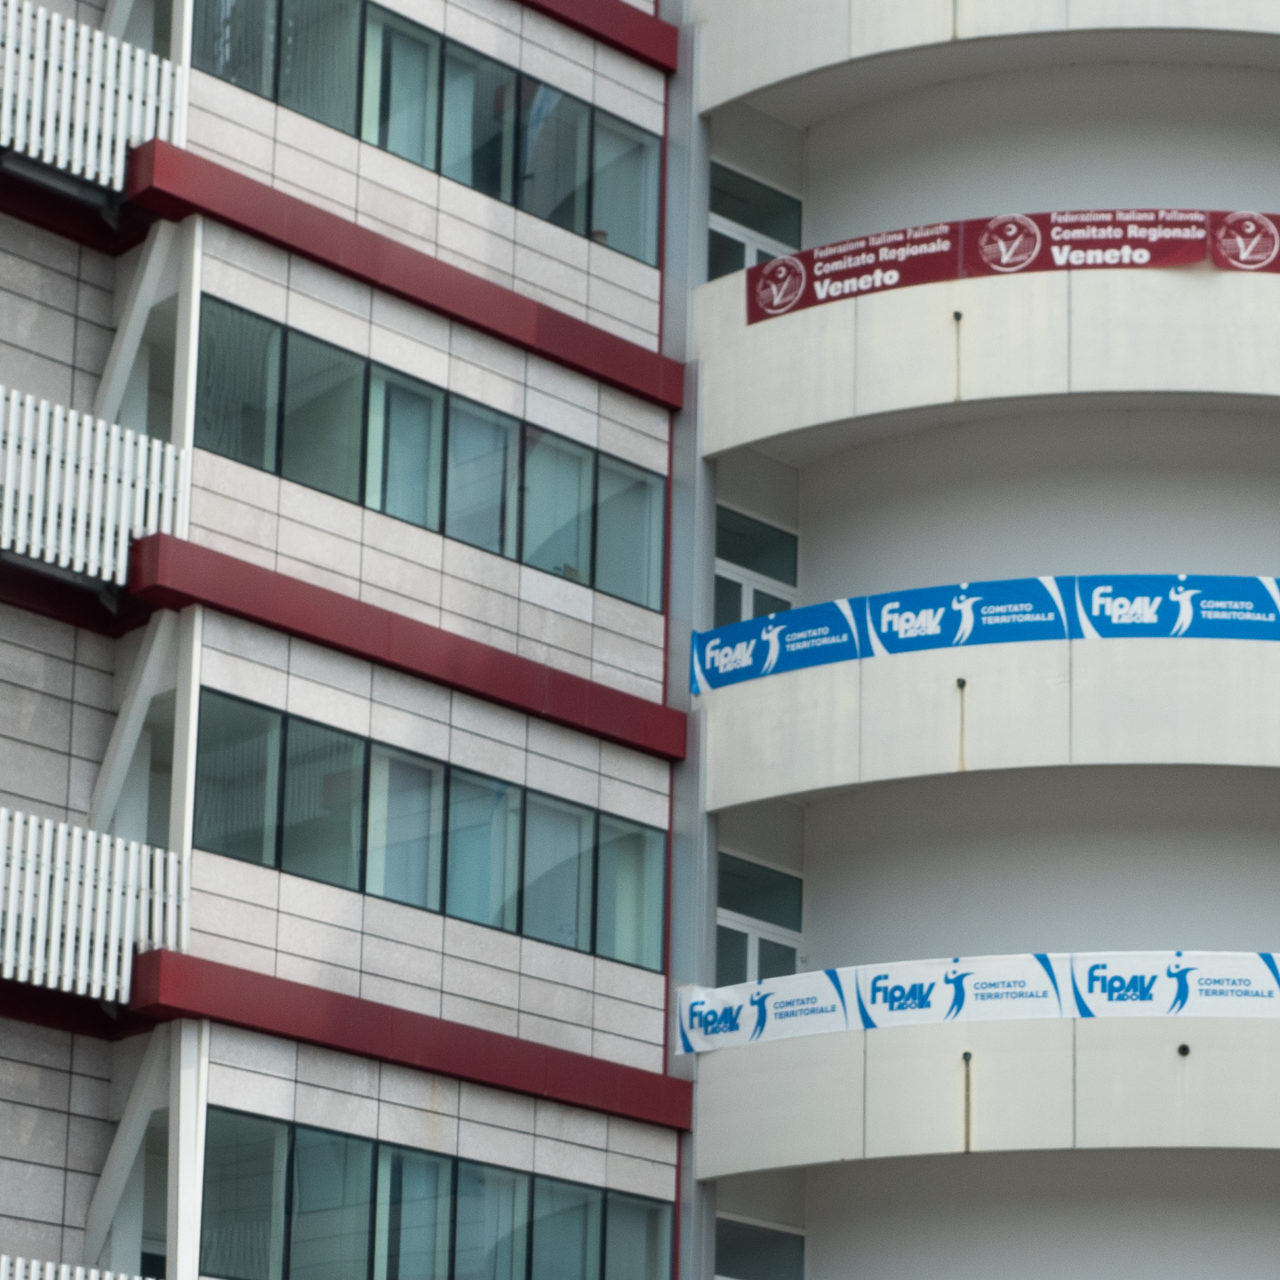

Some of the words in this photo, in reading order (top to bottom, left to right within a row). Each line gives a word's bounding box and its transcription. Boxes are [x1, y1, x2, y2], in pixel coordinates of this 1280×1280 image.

[1050, 225, 1123, 241] Comitato
[1127, 224, 1206, 242] Regionale
[814, 251, 875, 276] Comitato
[879, 239, 950, 262] Regionale
[1050, 245, 1150, 266] Veneto
[813, 268, 899, 300] Veneto
[981, 603, 1033, 615] COMITATO
[1200, 600, 1254, 610] COMITATO
[981, 612, 1055, 625] TERRITORIALE
[1200, 610, 1275, 622] TERRITORIALE
[785, 626, 829, 642] COMITATO
[785, 633, 848, 651] TERRITORIALE
[974, 980, 1026, 990] COMITATO
[1198, 978, 1251, 987] COMITATO
[974, 990, 1048, 1001] TERRITORIALE
[1198, 989, 1274, 998] TERRITORIALE
[773, 996, 817, 1009] COMITATO
[774, 1004, 836, 1020] TERRITORIALE
